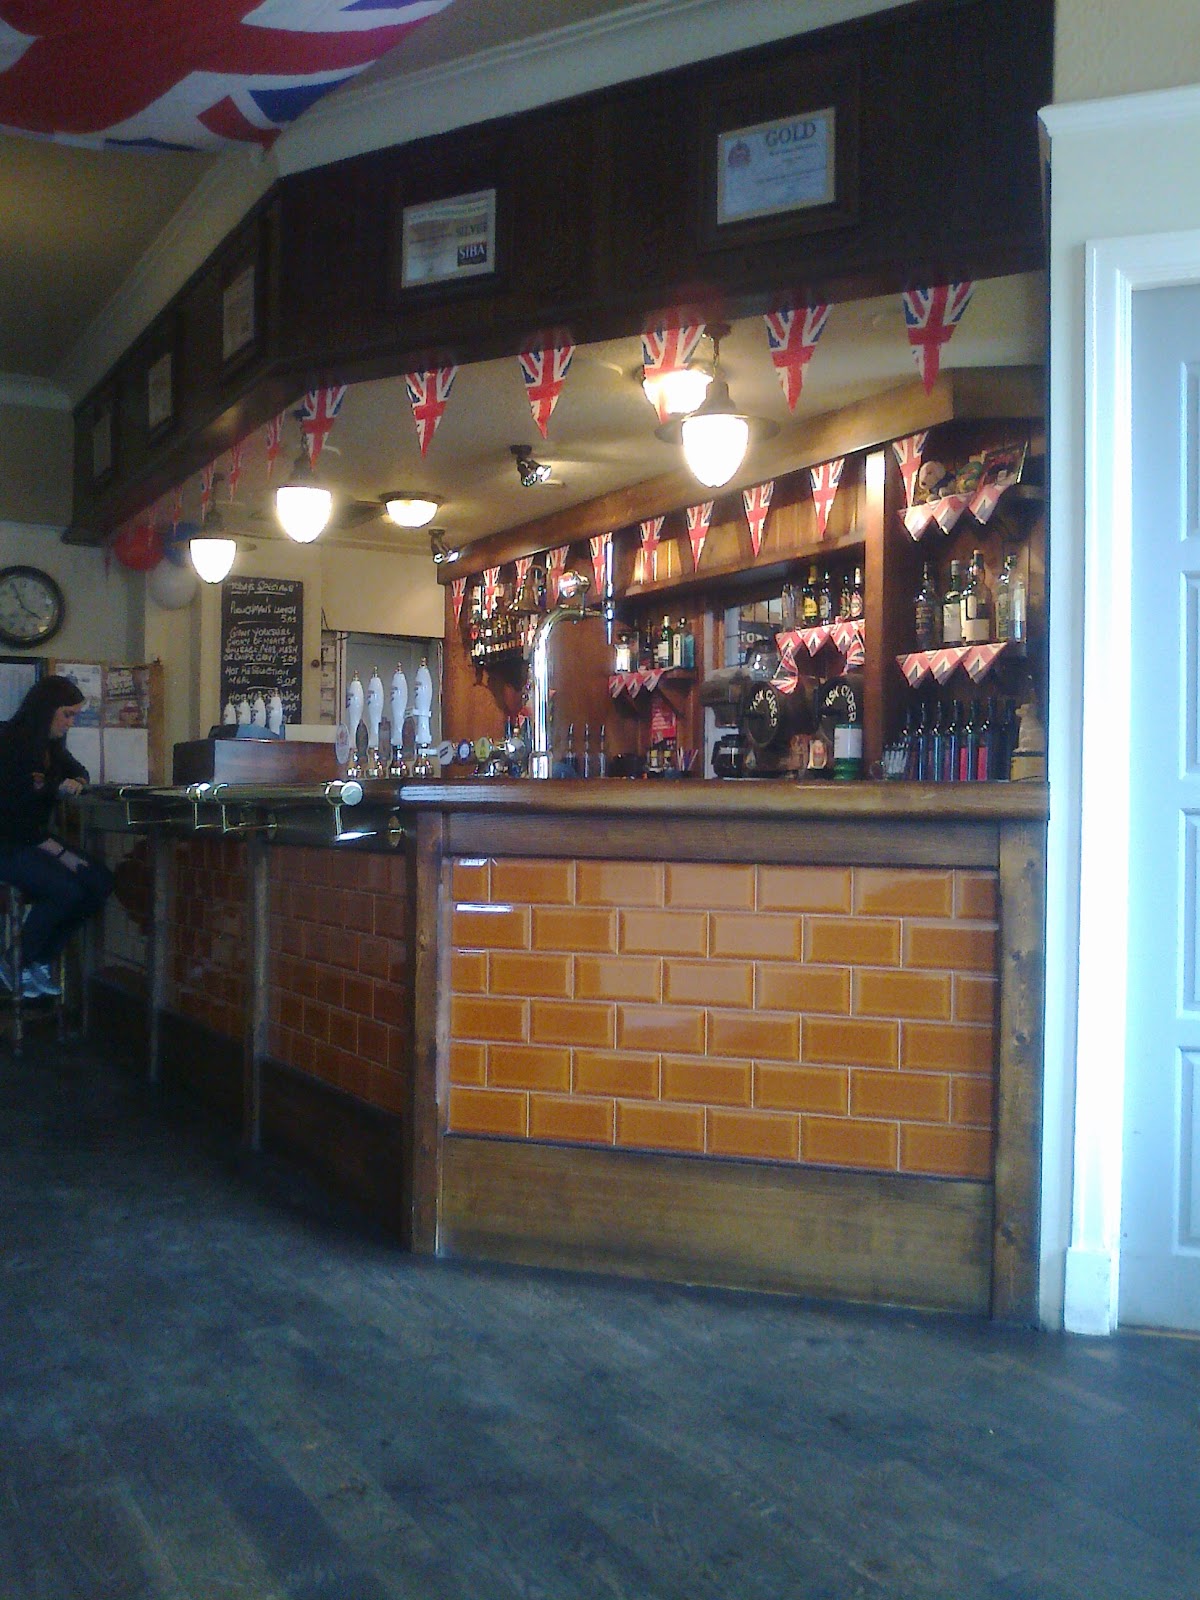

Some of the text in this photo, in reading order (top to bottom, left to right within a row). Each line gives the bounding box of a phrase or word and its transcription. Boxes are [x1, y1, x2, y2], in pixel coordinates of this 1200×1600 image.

[765, 121, 817, 147] GOLD
[459, 242, 485, 258] SIBA
[840, 684, 857, 723] CIDER
